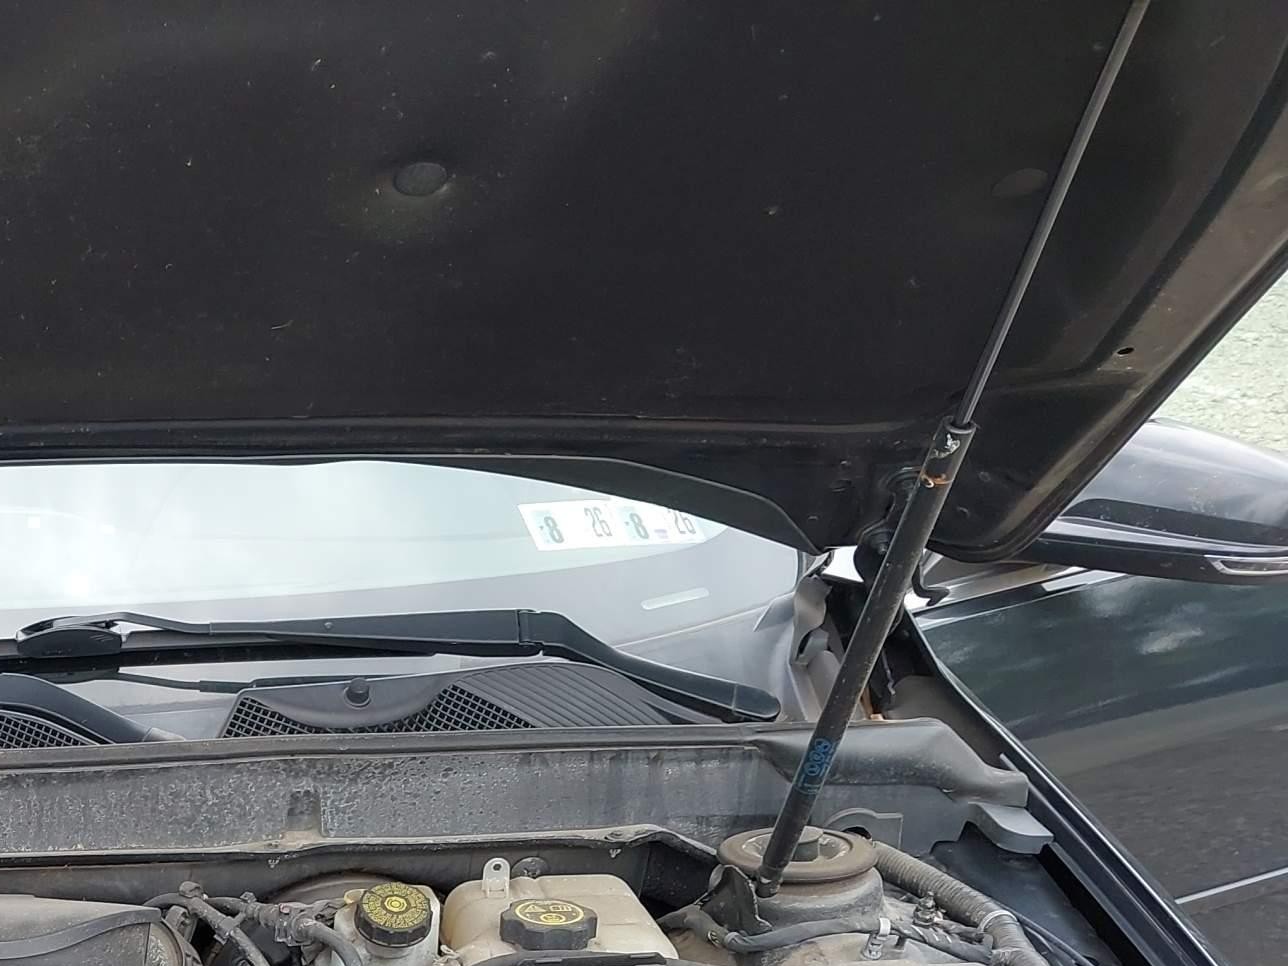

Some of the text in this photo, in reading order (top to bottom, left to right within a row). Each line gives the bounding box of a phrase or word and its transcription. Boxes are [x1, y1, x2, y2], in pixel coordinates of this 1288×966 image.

[543, 515, 564, 544] 8
[583, 506, 612, 538] 26
[629, 511, 650, 540] 8
